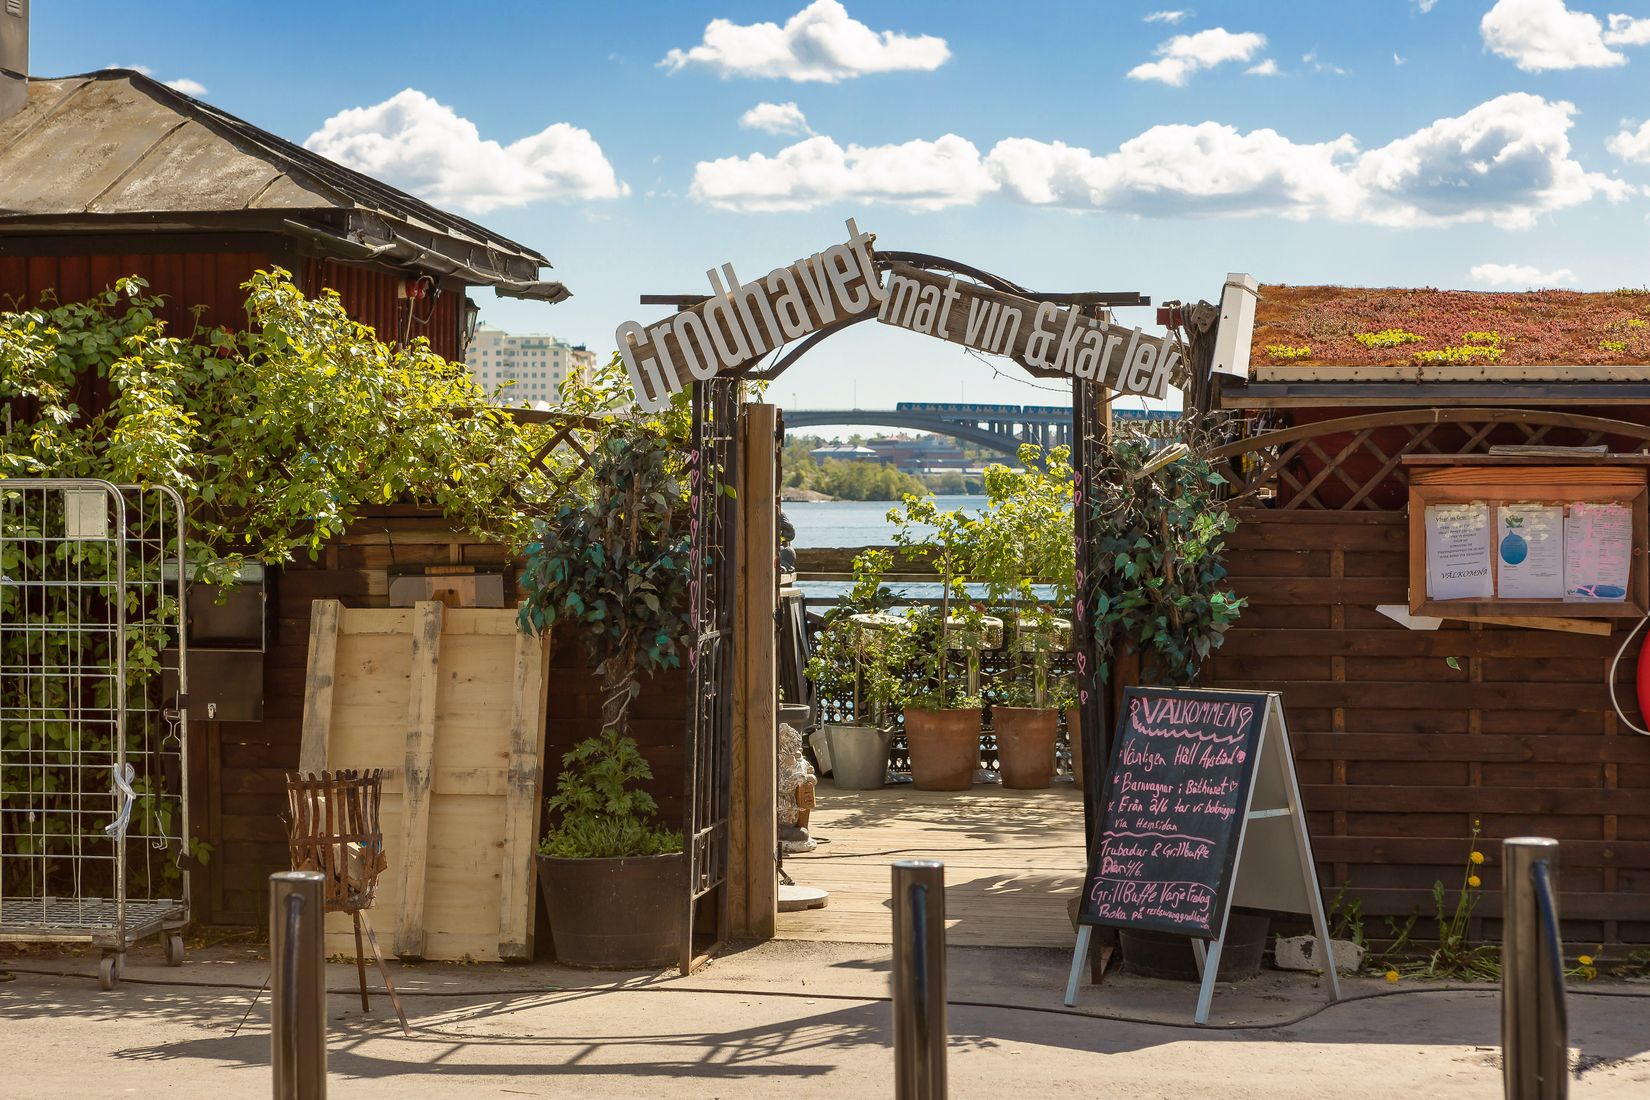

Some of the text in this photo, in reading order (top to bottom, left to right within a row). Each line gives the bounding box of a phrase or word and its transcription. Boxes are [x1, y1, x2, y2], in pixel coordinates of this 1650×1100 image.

[615, 217, 890, 413] Grodhavet
[878, 273, 961, 339] mat
[965, 296, 1022, 358] vin
[1024, 301, 1058, 370] &
[1122, 738, 1238, 771] Vänligen Håll Avstånd
[1120, 772, 1174, 797] Barnvagnar
[1178, 783, 1182, 794] i
[1118, 796, 1143, 813] Från
[1149, 798, 1168, 815] 2/6
[1175, 799, 1192, 813] tar
[1193, 802, 1202, 813] vi
[1101, 839, 1148, 858] Trubadur
[1151, 842, 1160, 857] &
[1160, 882, 1186, 908] Varje
[1099, 904, 1126, 920] Boka
[1131, 906, 1144, 920] på
